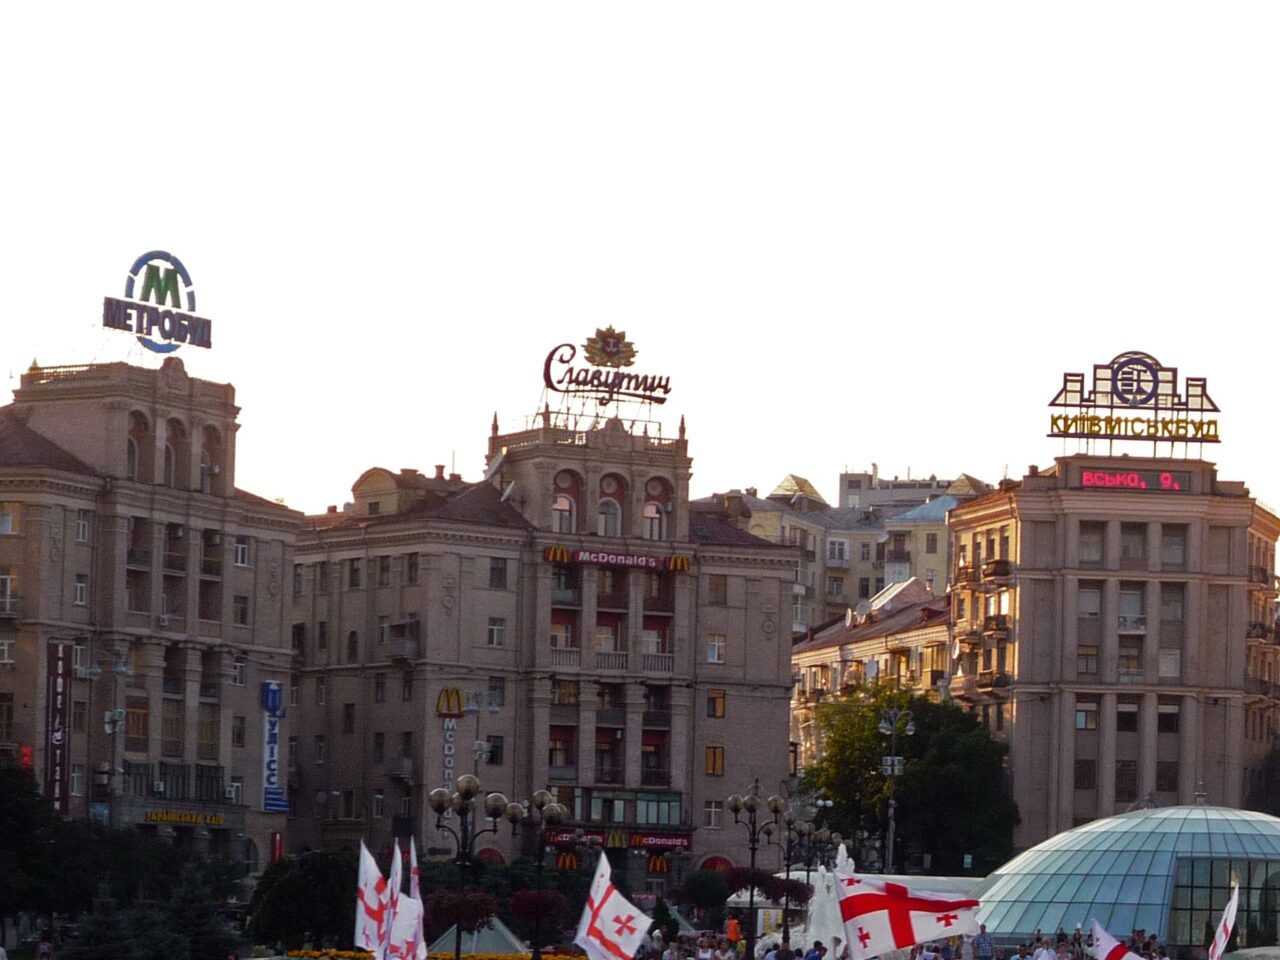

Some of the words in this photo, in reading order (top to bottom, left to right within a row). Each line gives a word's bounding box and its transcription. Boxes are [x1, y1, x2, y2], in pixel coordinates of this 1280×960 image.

[102, 296, 212, 349] МЕТРОБУД
[542, 343, 672, 406] Славутич
[1050, 411, 1219, 440] КИЇВМІСЬКБУД
[578, 550, 657, 567] McDonald's
